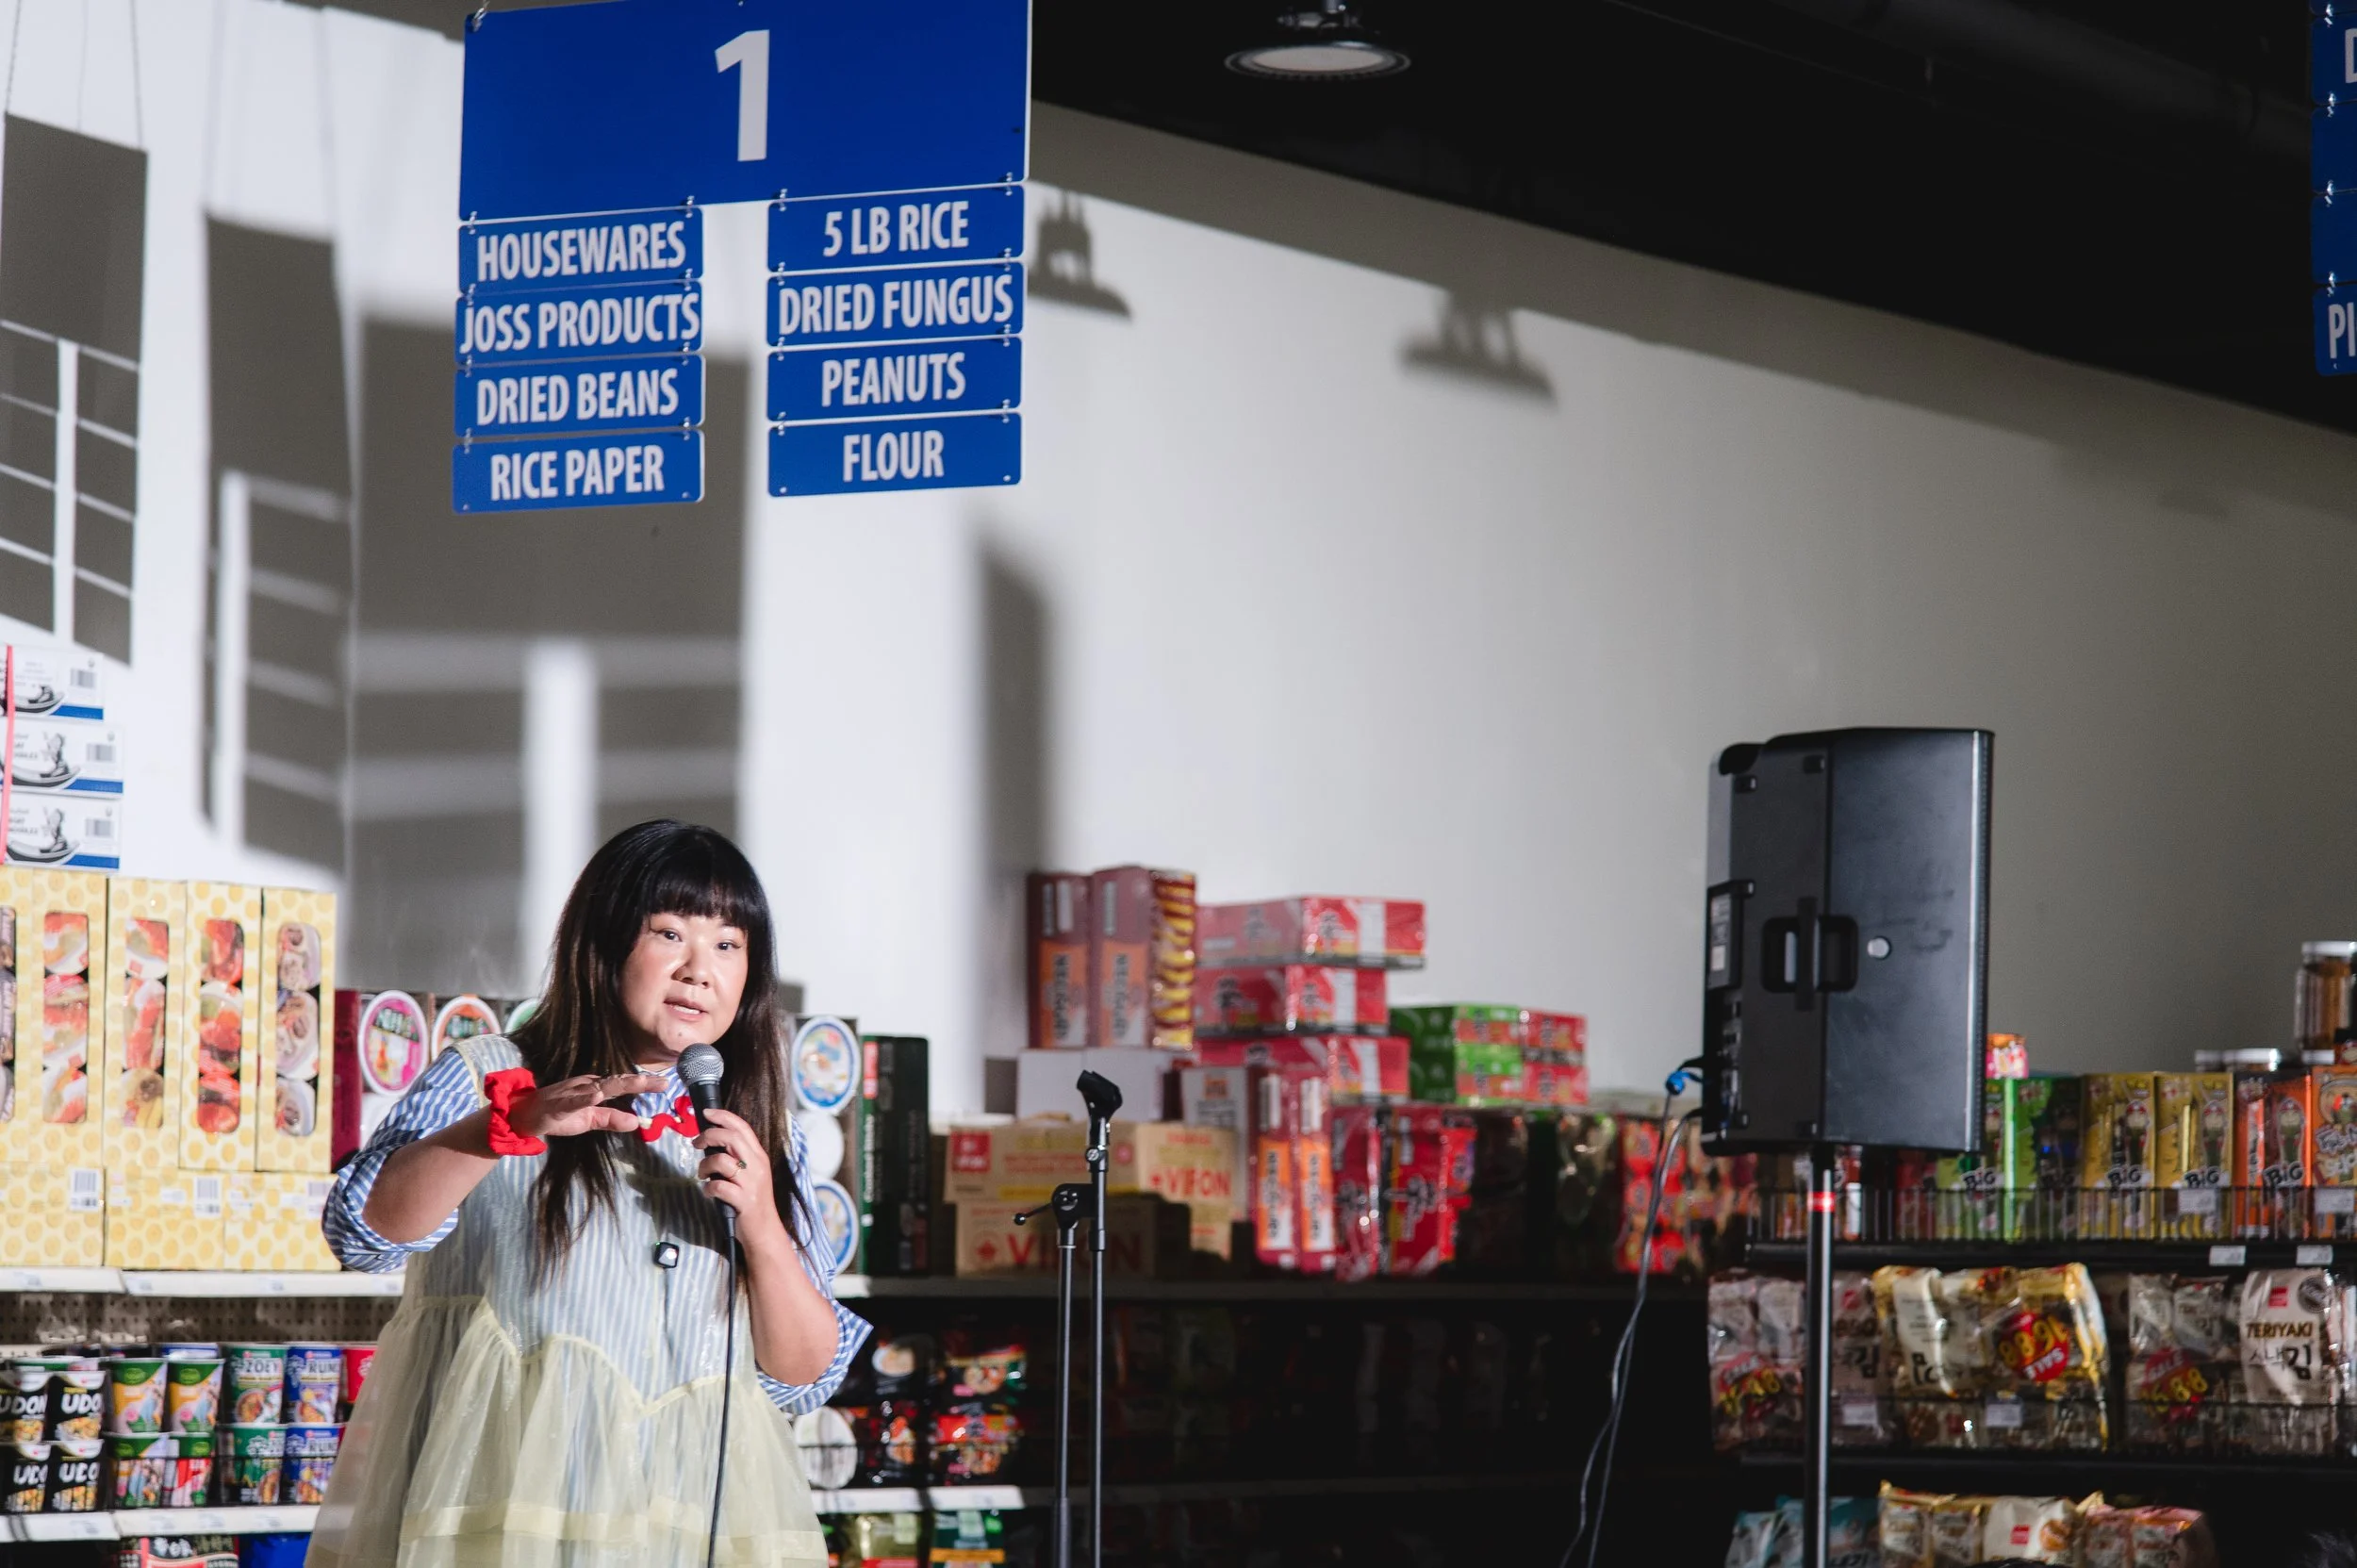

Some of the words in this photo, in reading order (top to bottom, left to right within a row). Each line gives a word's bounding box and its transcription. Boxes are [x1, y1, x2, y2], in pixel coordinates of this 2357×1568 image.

[715, 29, 769, 161] 1
[477, 222, 686, 282] HOUSEWARES
[823, 212, 843, 257] 5
[851, 207, 891, 255] LB
[898, 201, 969, 251] RICE
[460, 303, 531, 354] JOSS
[538, 292, 701, 348] PRODUCTS
[779, 285, 875, 335] DRIED
[882, 274, 1014, 330] FUNGUS
[477, 375, 570, 425] DRIED
[577, 368, 679, 420] BEANS
[822, 353, 966, 407] PEANUTS
[490, 452, 558, 502] RICE
[566, 444, 665, 496] PAPER
[843, 430, 944, 482] FLOUR
[2246, 1322, 2314, 1338] TERIYAKI
